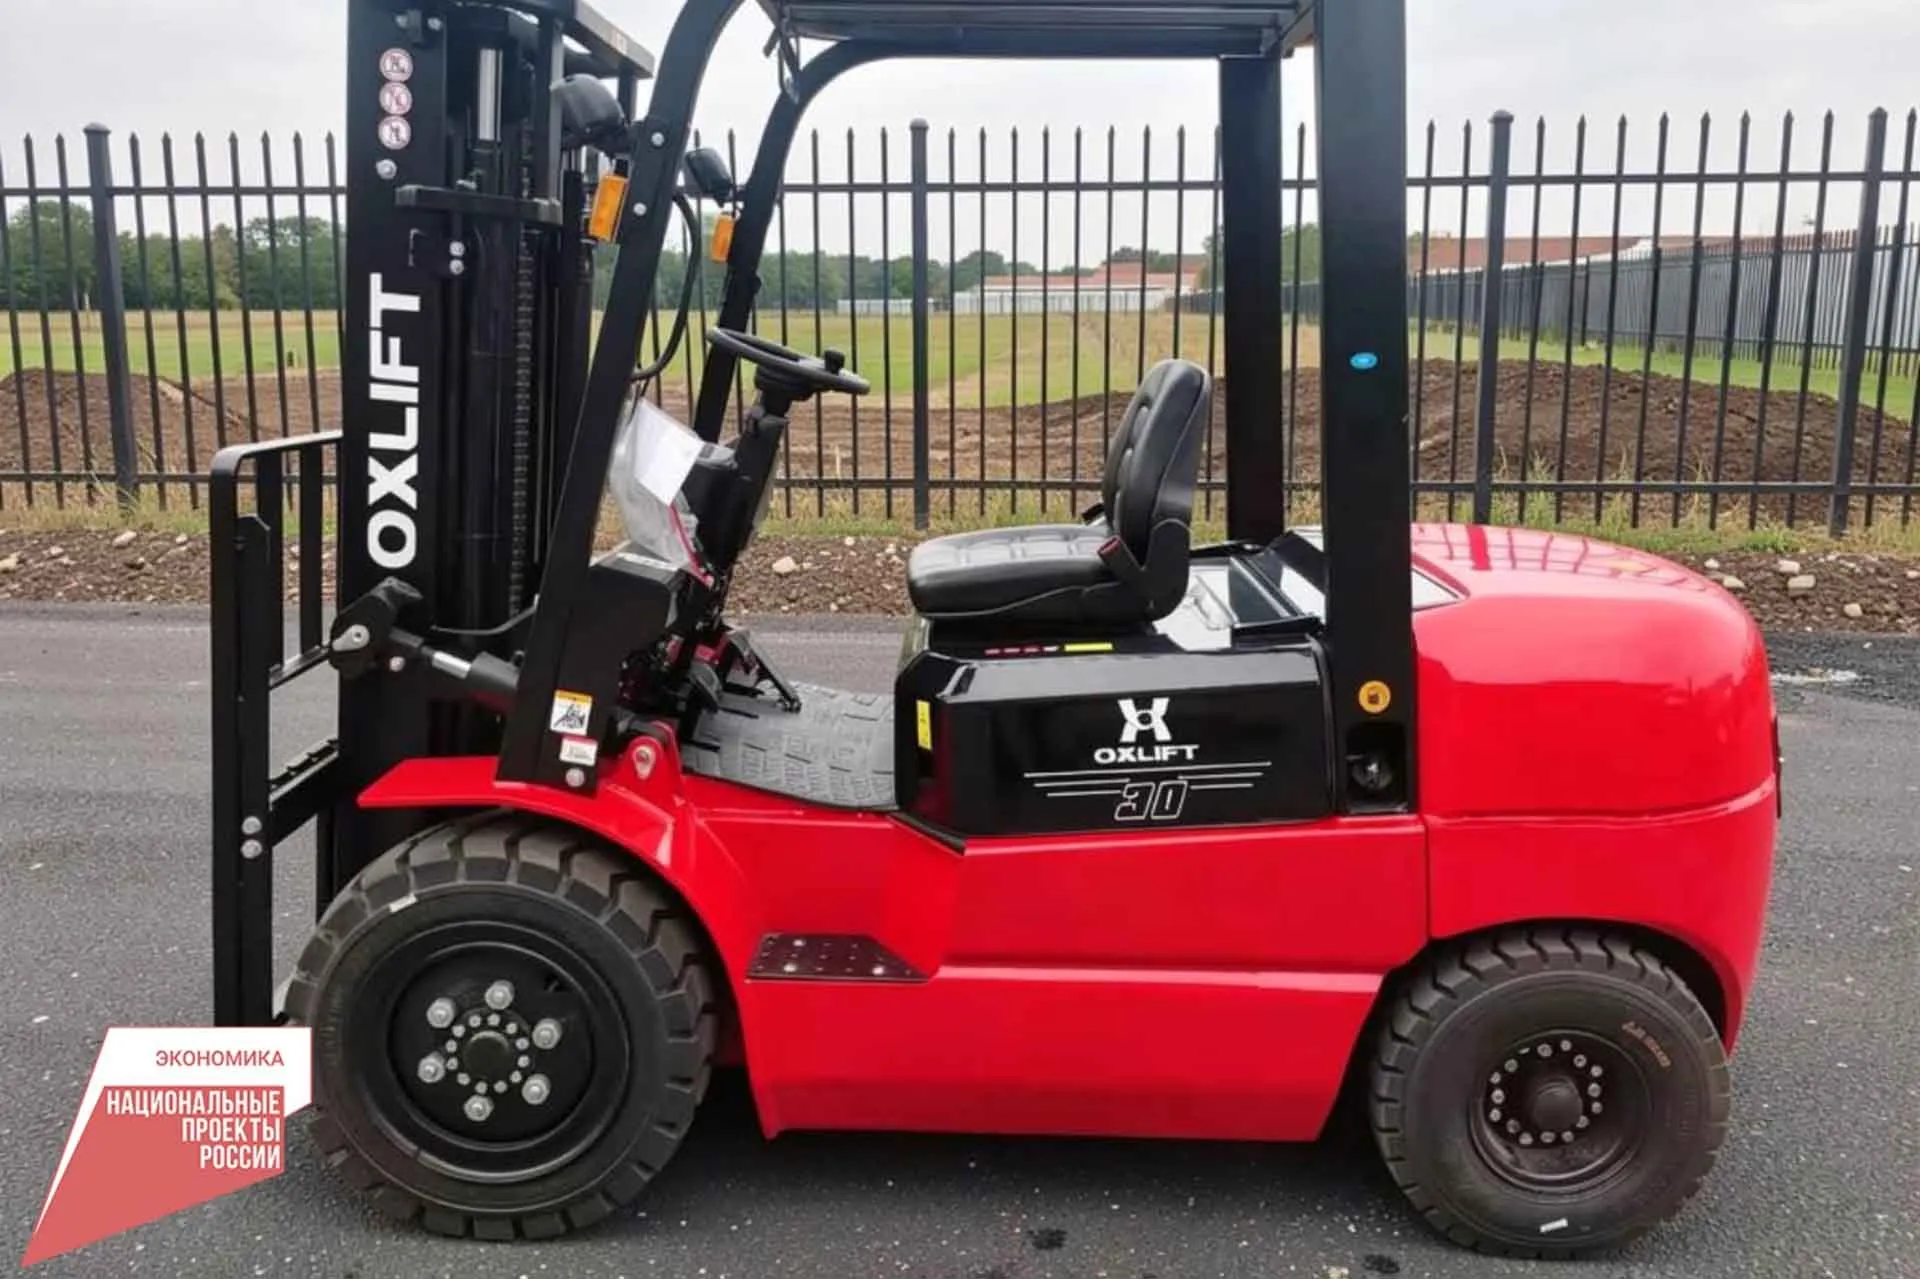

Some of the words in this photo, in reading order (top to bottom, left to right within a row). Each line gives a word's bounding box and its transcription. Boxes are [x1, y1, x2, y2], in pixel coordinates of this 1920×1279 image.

[367, 272, 420, 569] OXLIFT
[1093, 743, 1200, 764] OXLIFT
[1113, 780, 1188, 821] 30
